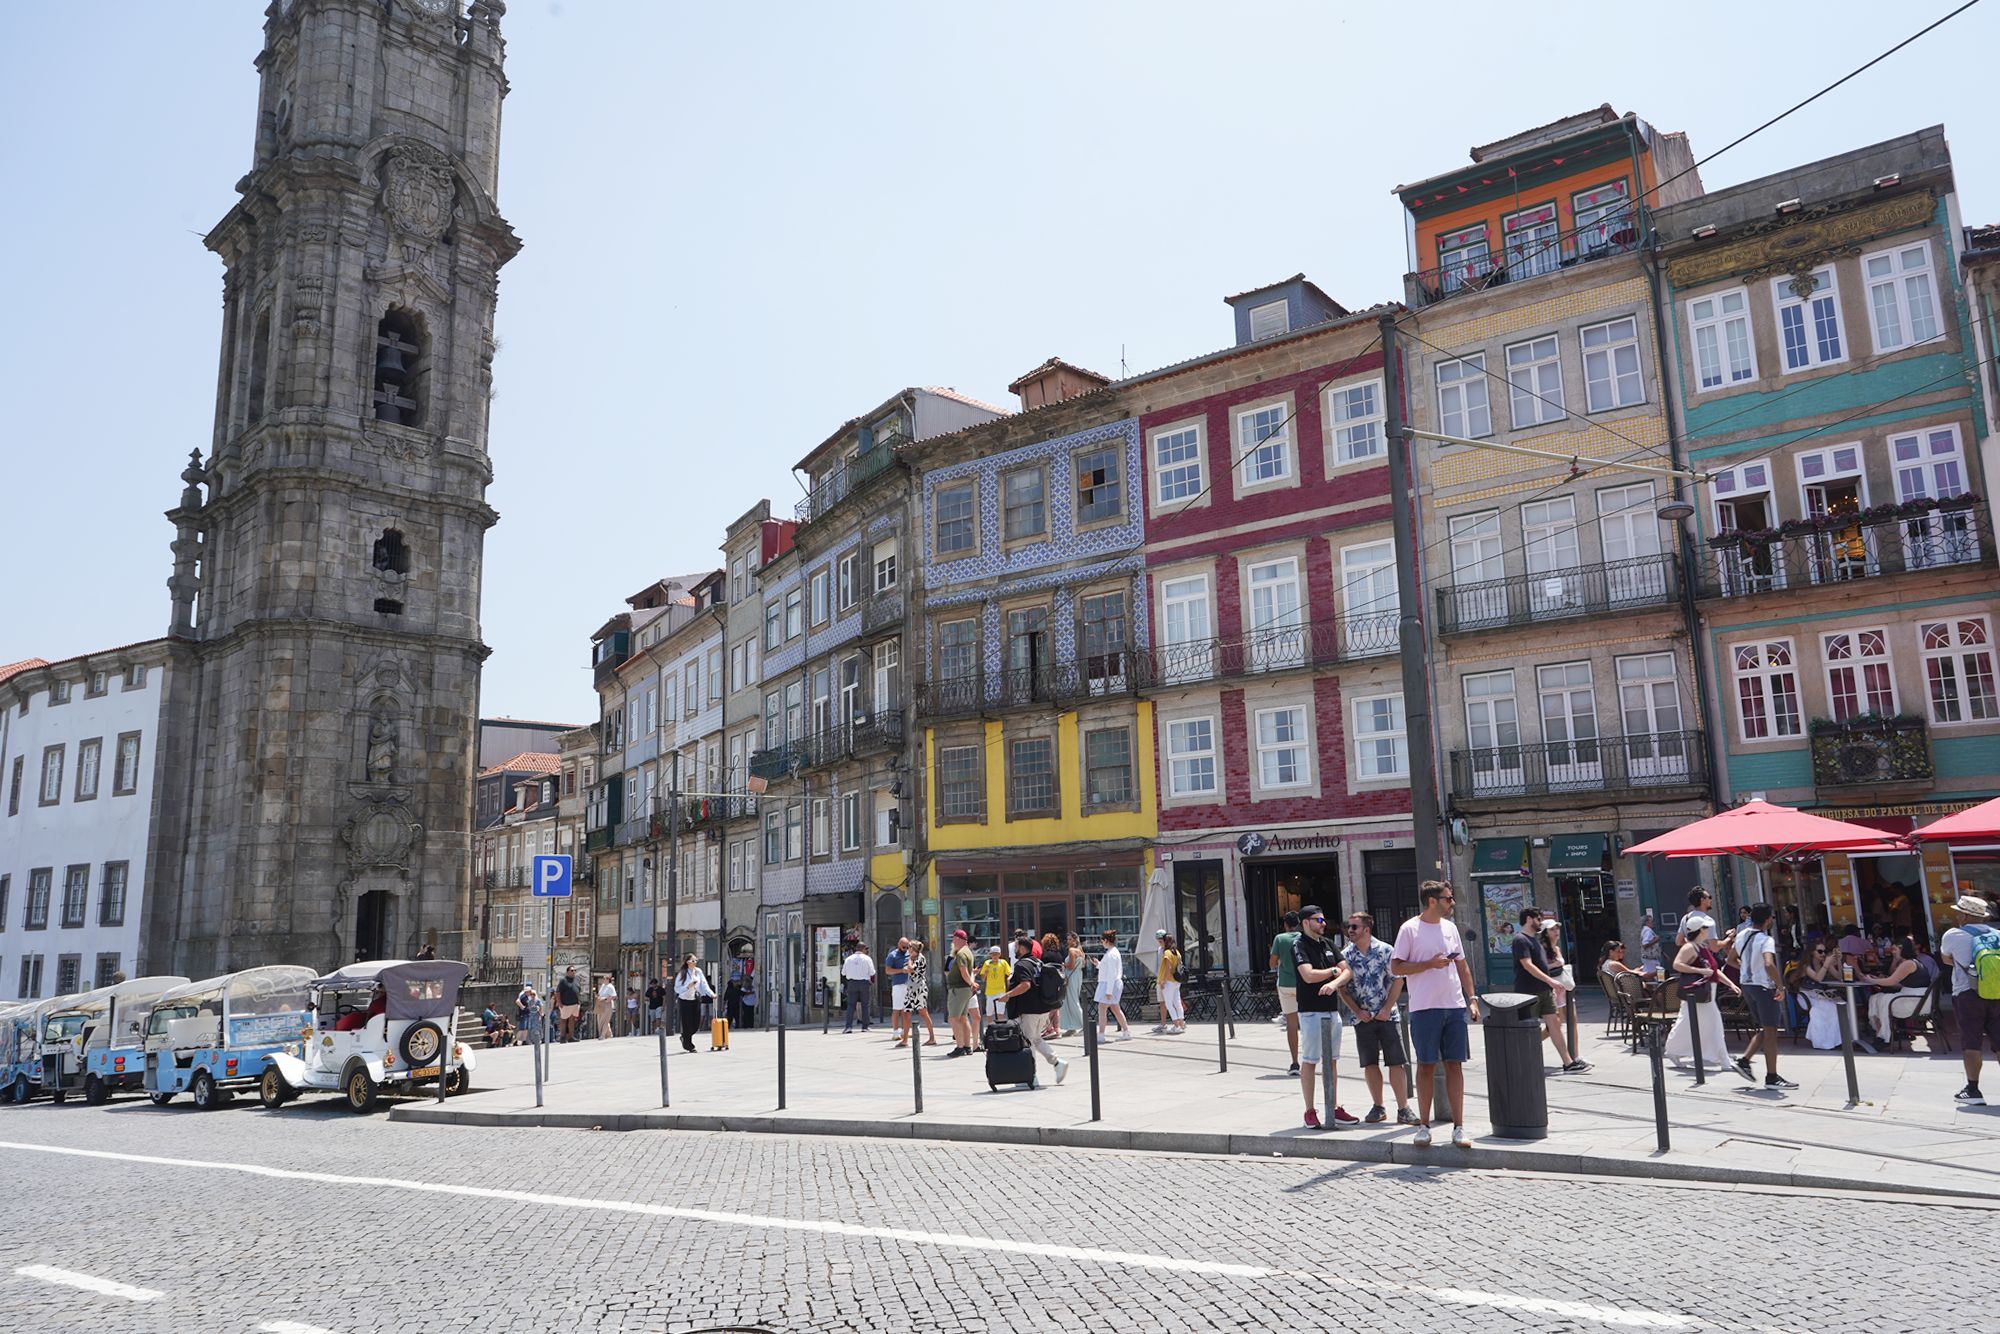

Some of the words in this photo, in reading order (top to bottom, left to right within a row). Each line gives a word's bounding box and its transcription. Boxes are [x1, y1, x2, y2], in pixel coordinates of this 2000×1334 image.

[1864, 808, 1877, 818] DO
[1880, 805, 1921, 817] PASTEL
[1924, 803, 1937, 814] DE
[1267, 832, 1341, 851] Amorino
[541, 859, 564, 893] P
